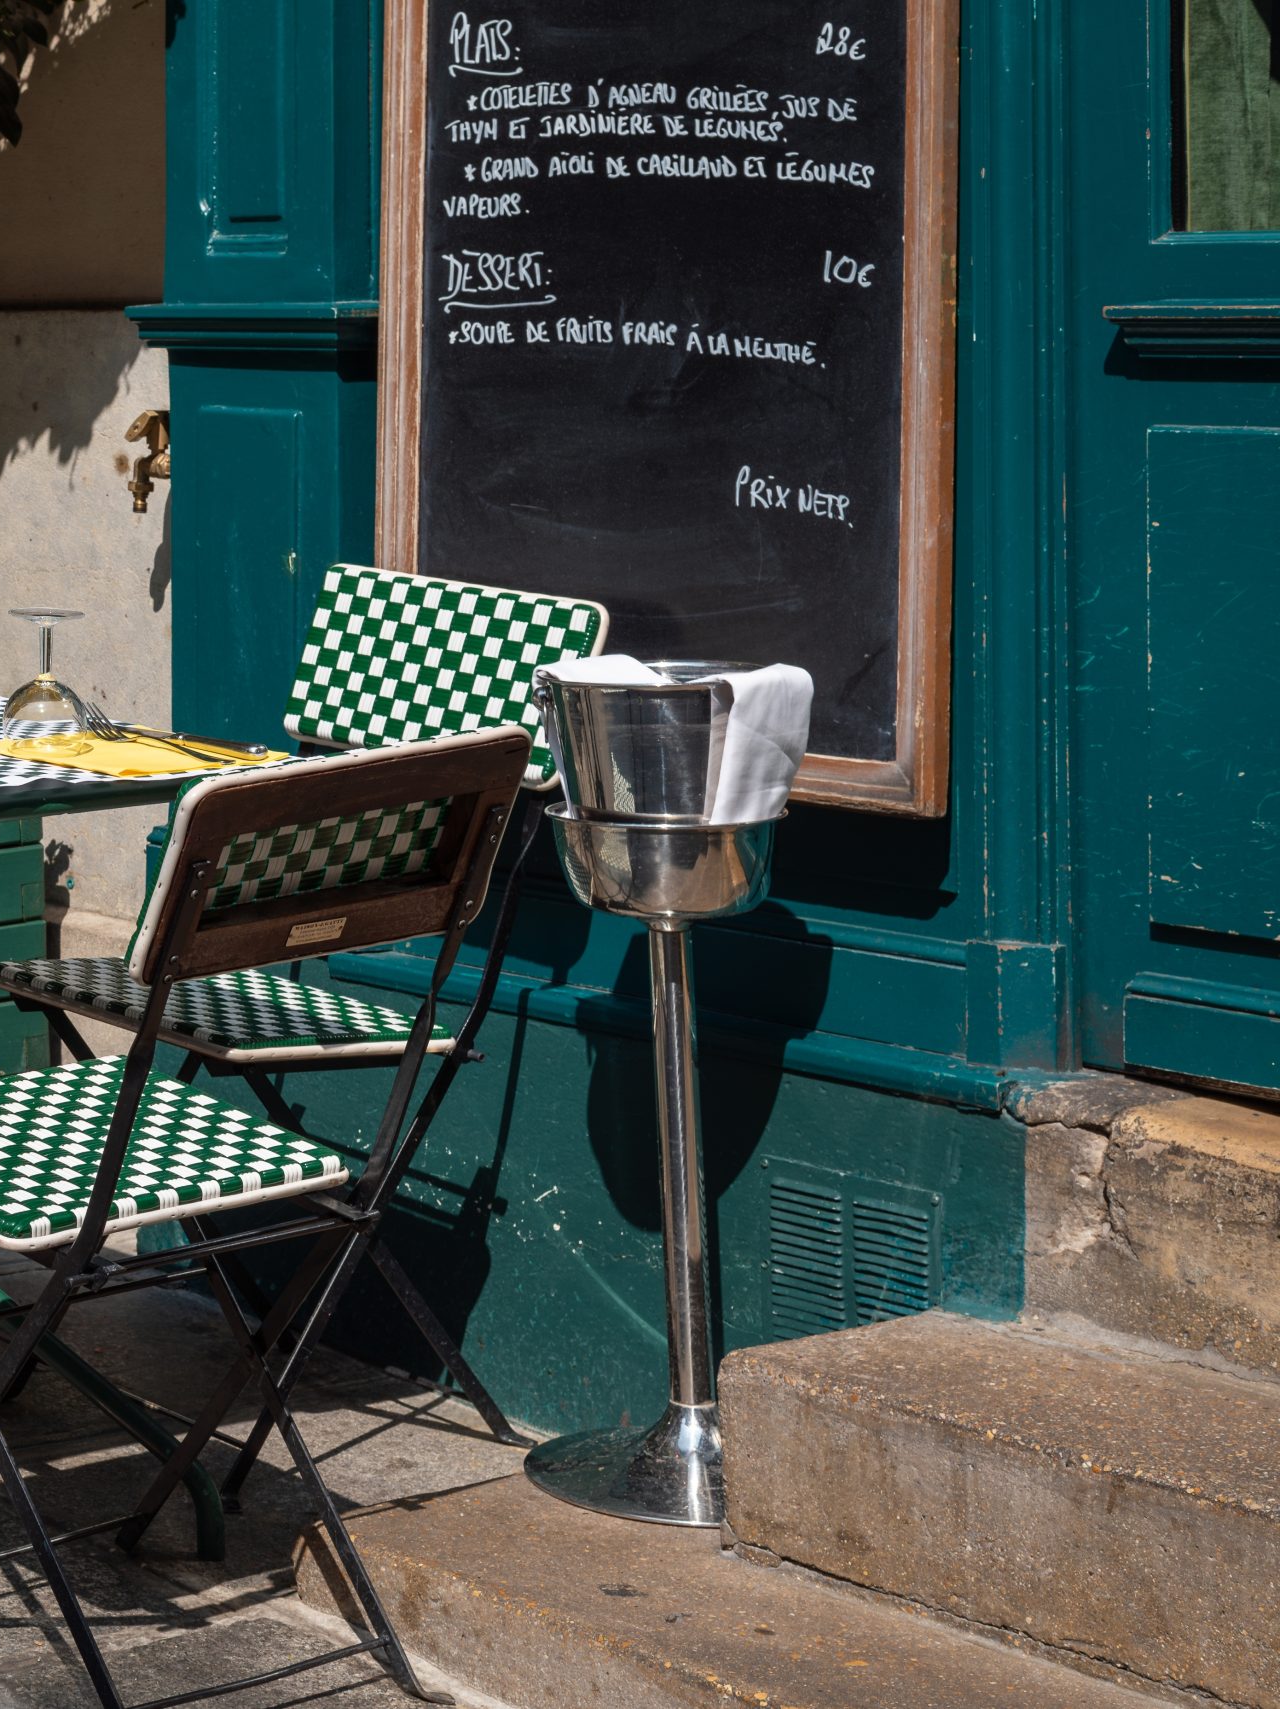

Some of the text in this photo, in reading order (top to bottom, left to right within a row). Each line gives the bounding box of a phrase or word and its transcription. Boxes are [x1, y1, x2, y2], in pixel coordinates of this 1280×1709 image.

[450, 11, 521, 64] PLATS:
[816, 22, 866, 60] 28€
[779, 94, 821, 119] JUS
[827, 98, 858, 121] DE
[444, 117, 498, 144] THYM
[508, 117, 531, 139] ET
[662, 115, 689, 137] DE
[481, 156, 539, 182] GRAND
[606, 156, 631, 179] DE
[744, 156, 767, 178] ET
[776, 152, 875, 189] LÉGUMES
[442, 193, 530, 219] VAPEURS.
[438, 249, 553, 301] DESSERT:
[824, 250, 875, 288] 10€
[458, 321, 515, 345] SOUPE
[526, 321, 550, 343] DE
[707, 333, 731, 356] LA
